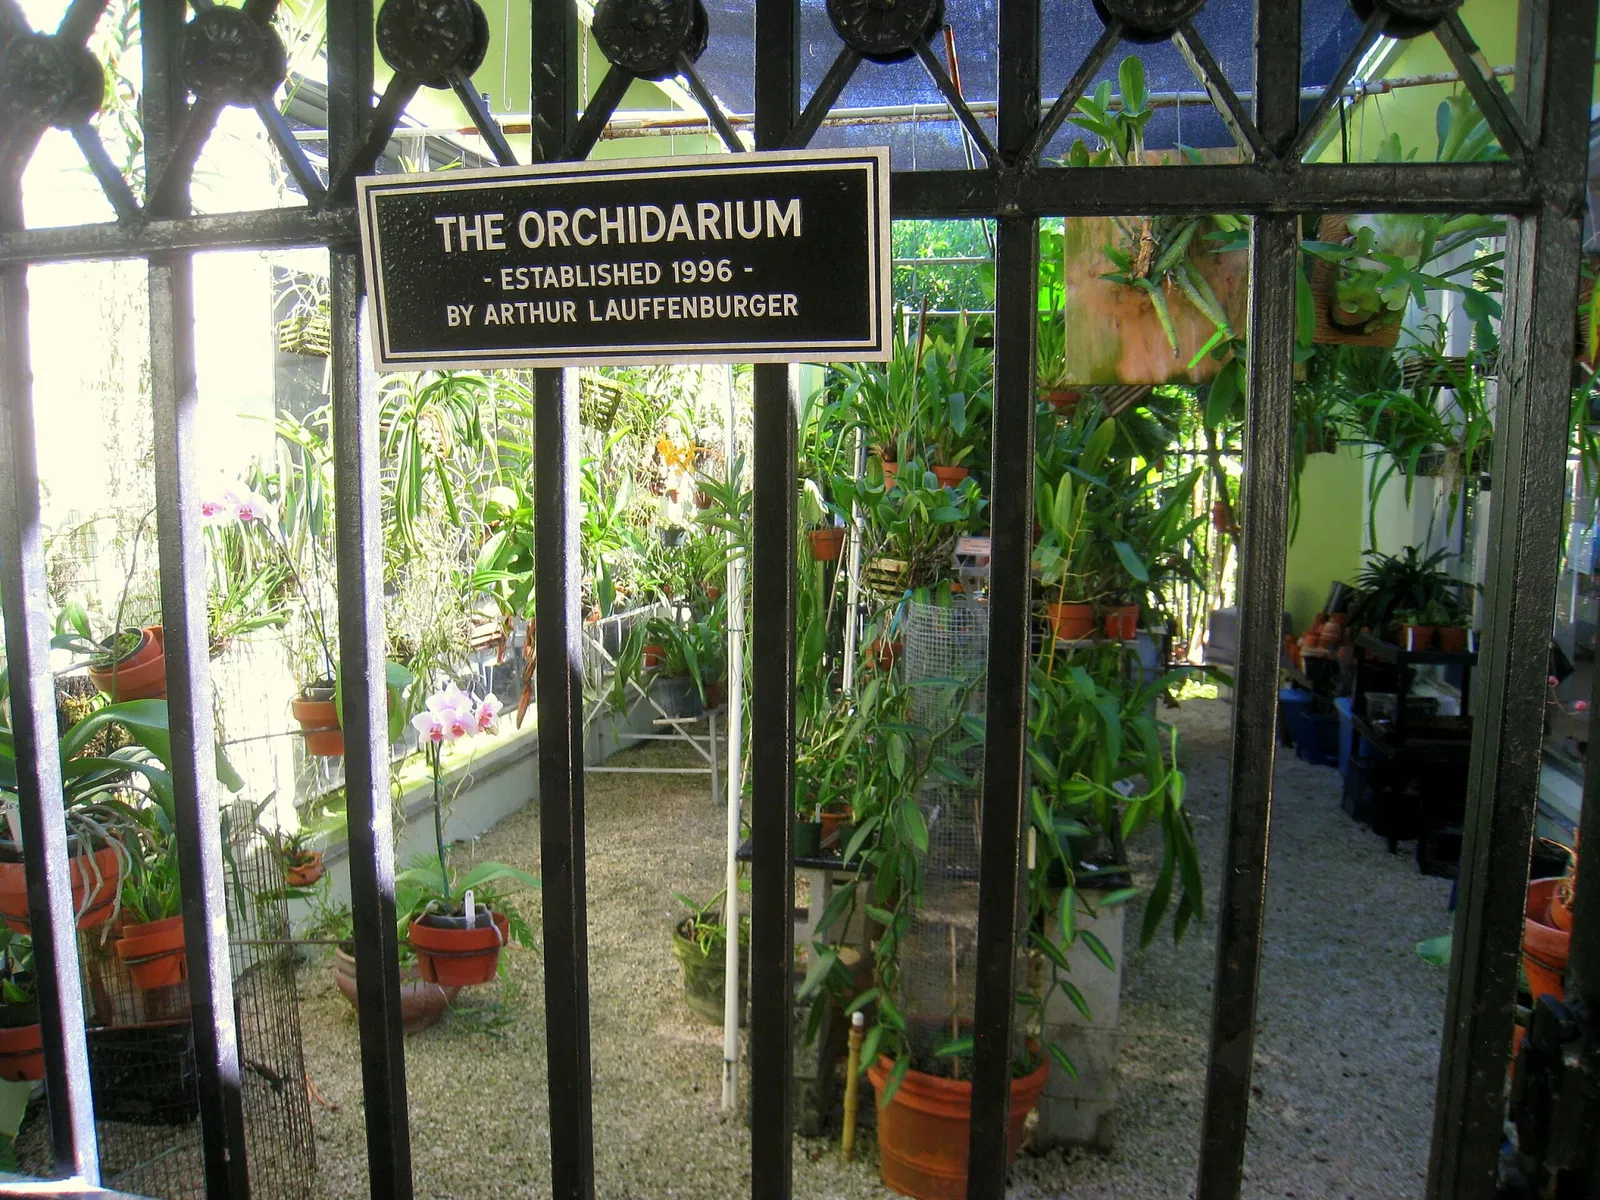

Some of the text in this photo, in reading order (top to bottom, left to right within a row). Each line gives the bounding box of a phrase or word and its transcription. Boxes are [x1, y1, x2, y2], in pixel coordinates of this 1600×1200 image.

[434, 198, 801, 253] THE ORCHIDARIUM
[500, 262, 662, 291] ESTABLISHED
[671, 258, 733, 284] 1996
[446, 293, 799, 327] BY ARTHUR LAUFFENBURGER
